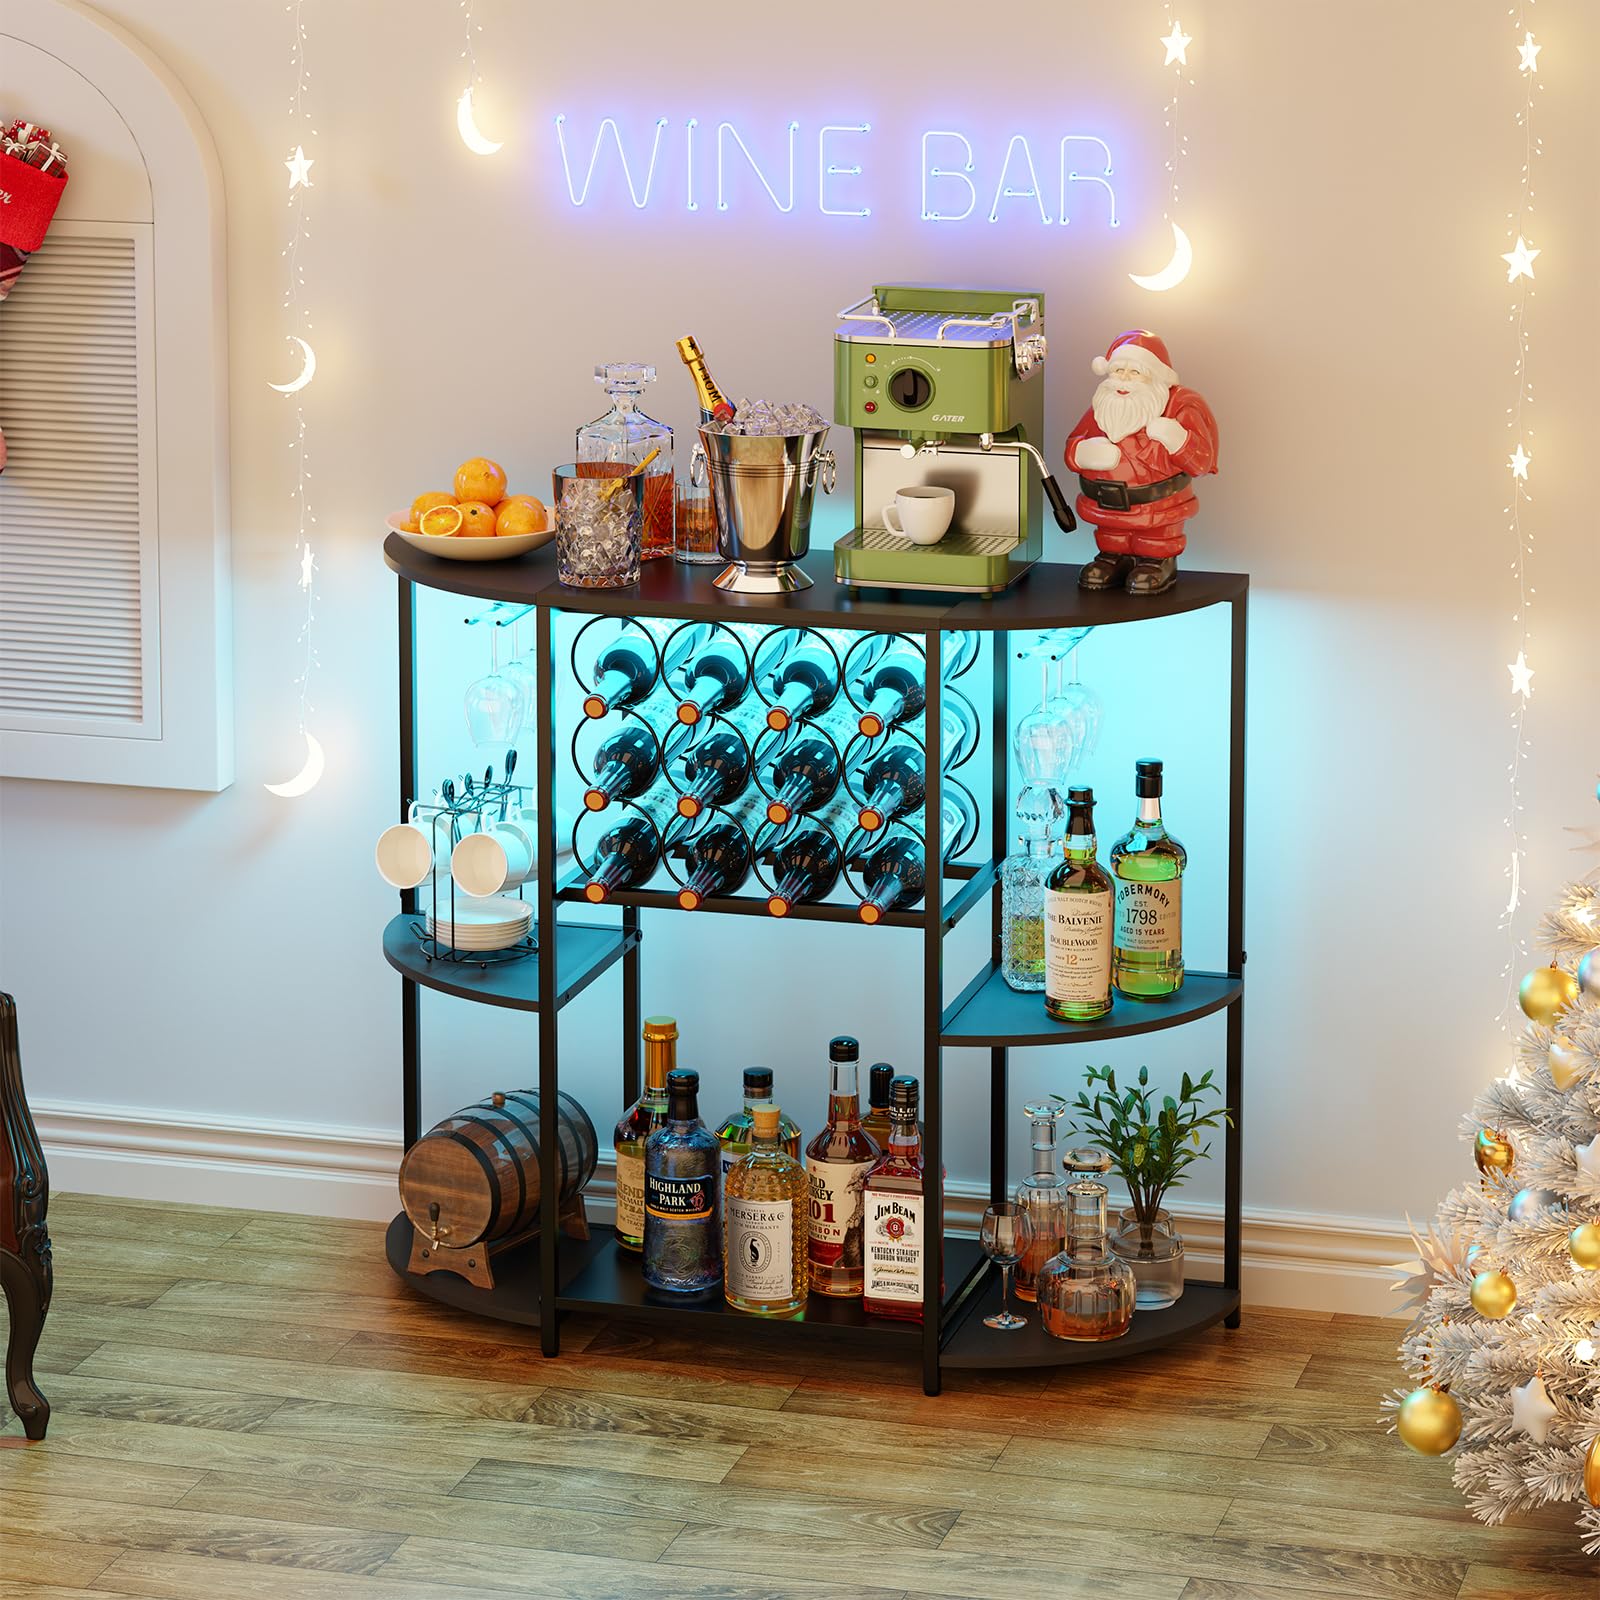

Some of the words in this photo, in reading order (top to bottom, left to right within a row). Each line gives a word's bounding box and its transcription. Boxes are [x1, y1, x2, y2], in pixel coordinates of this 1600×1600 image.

[555, 113, 871, 217] WINE
[921, 131, 1120, 227] BAR
[931, 414, 966, 423] GATER
[1117, 884, 1170, 908] TOBERMORY
[1047, 912, 1056, 922] THE
[1058, 914, 1102, 925] BALVENIE
[1127, 908, 1157, 925] 1798
[1121, 926, 1133, 934] AGED
[1145, 928, 1165, 936] YEARS
[1066, 954, 1078, 965] 12
[649, 1176, 701, 1194] HIGHLAND
[659, 1193, 687, 1206] PARK
[808, 1197, 836, 1223] 101
[874, 1204, 890, 1221] JIM
[892, 1201, 916, 1224] BEAM
[871, 1246, 896, 1255] KENTUCKY
[896, 1248, 919, 1257] STRAIGHT
[874, 1253, 896, 1262] BOURBON
[896, 1255, 916, 1263] WHISKEY
